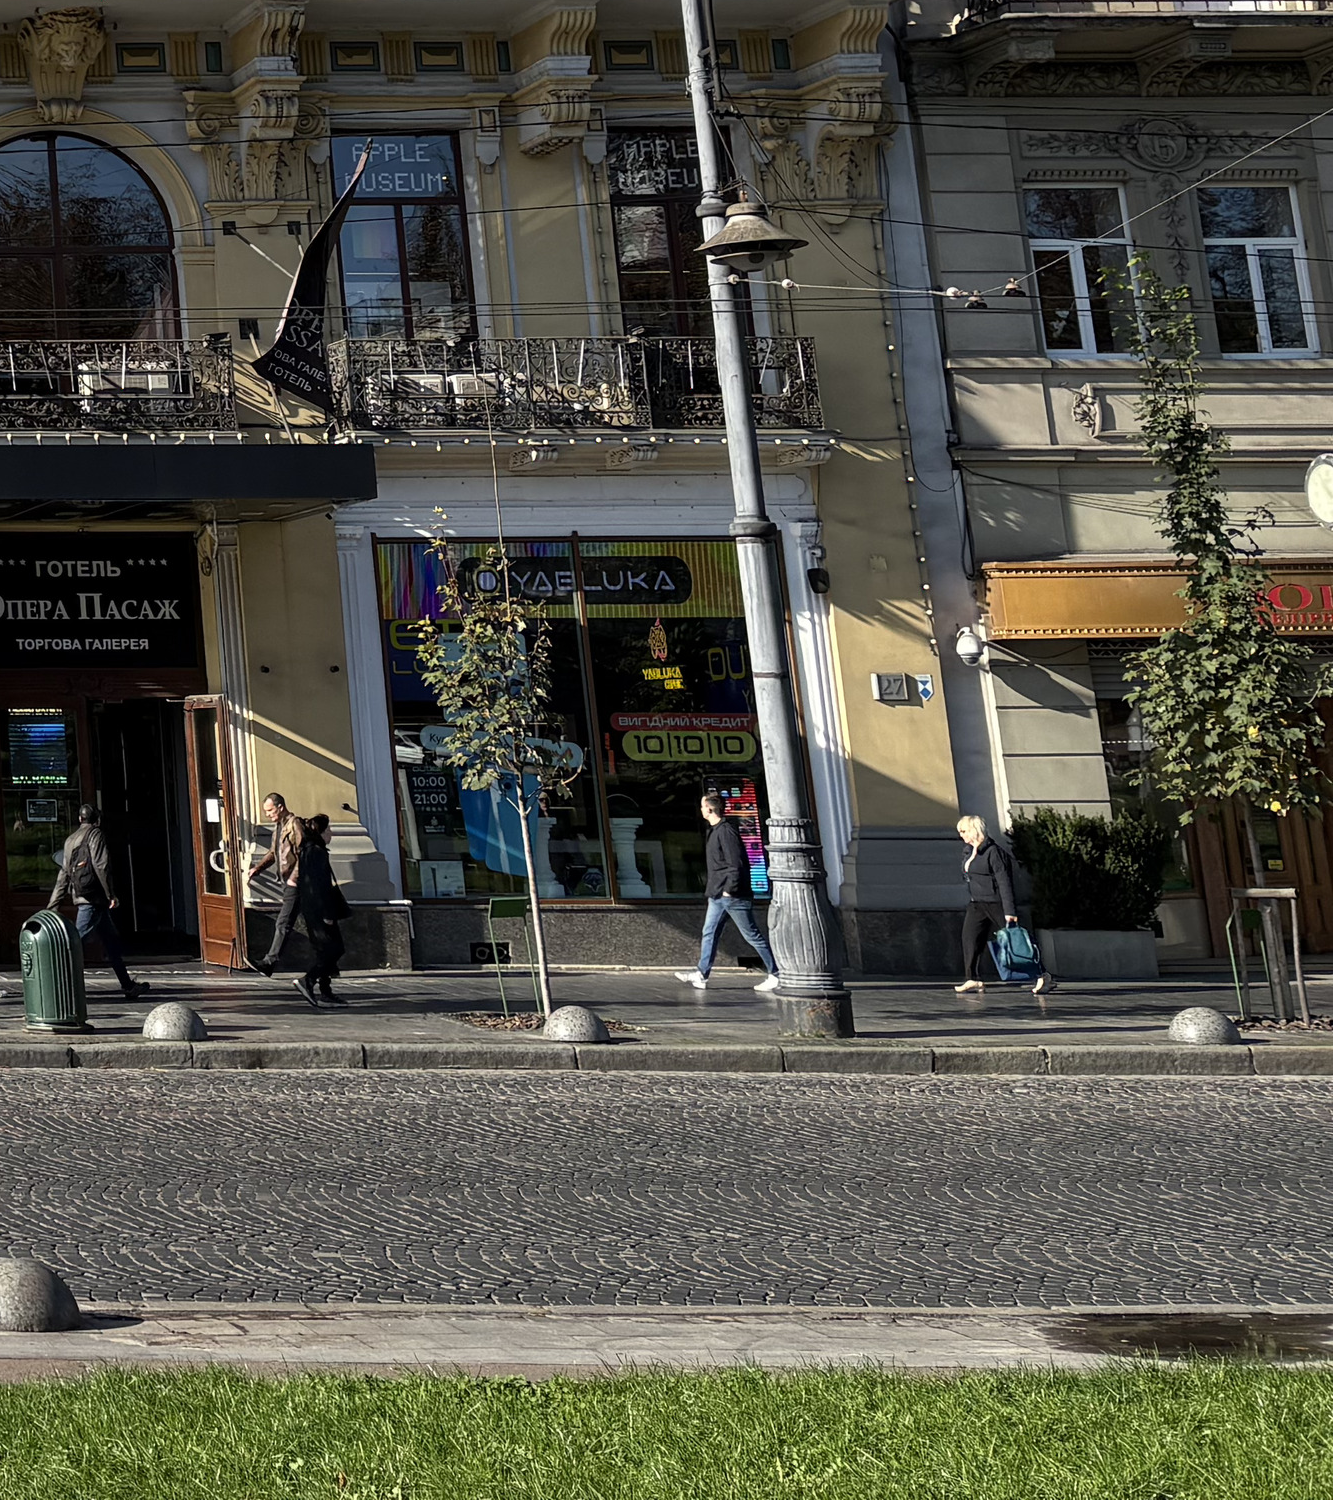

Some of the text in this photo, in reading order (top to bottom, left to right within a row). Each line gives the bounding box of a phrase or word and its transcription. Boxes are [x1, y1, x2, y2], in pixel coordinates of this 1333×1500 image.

[352, 143, 430, 162] APPLE
[267, 362, 312, 392] ГОТЕЛЬ
[35, 560, 121, 577] ГОТЕЛЬ
[16, 639, 149, 650] ТОРГОВА ГАЛЕРЕЯ
[882, 677, 903, 696] 27
[618, 716, 750, 728] ВИГІДНИЙ КРЕДИТ
[412, 776, 446, 787] 10:00
[414, 793, 448, 805] 21:00
